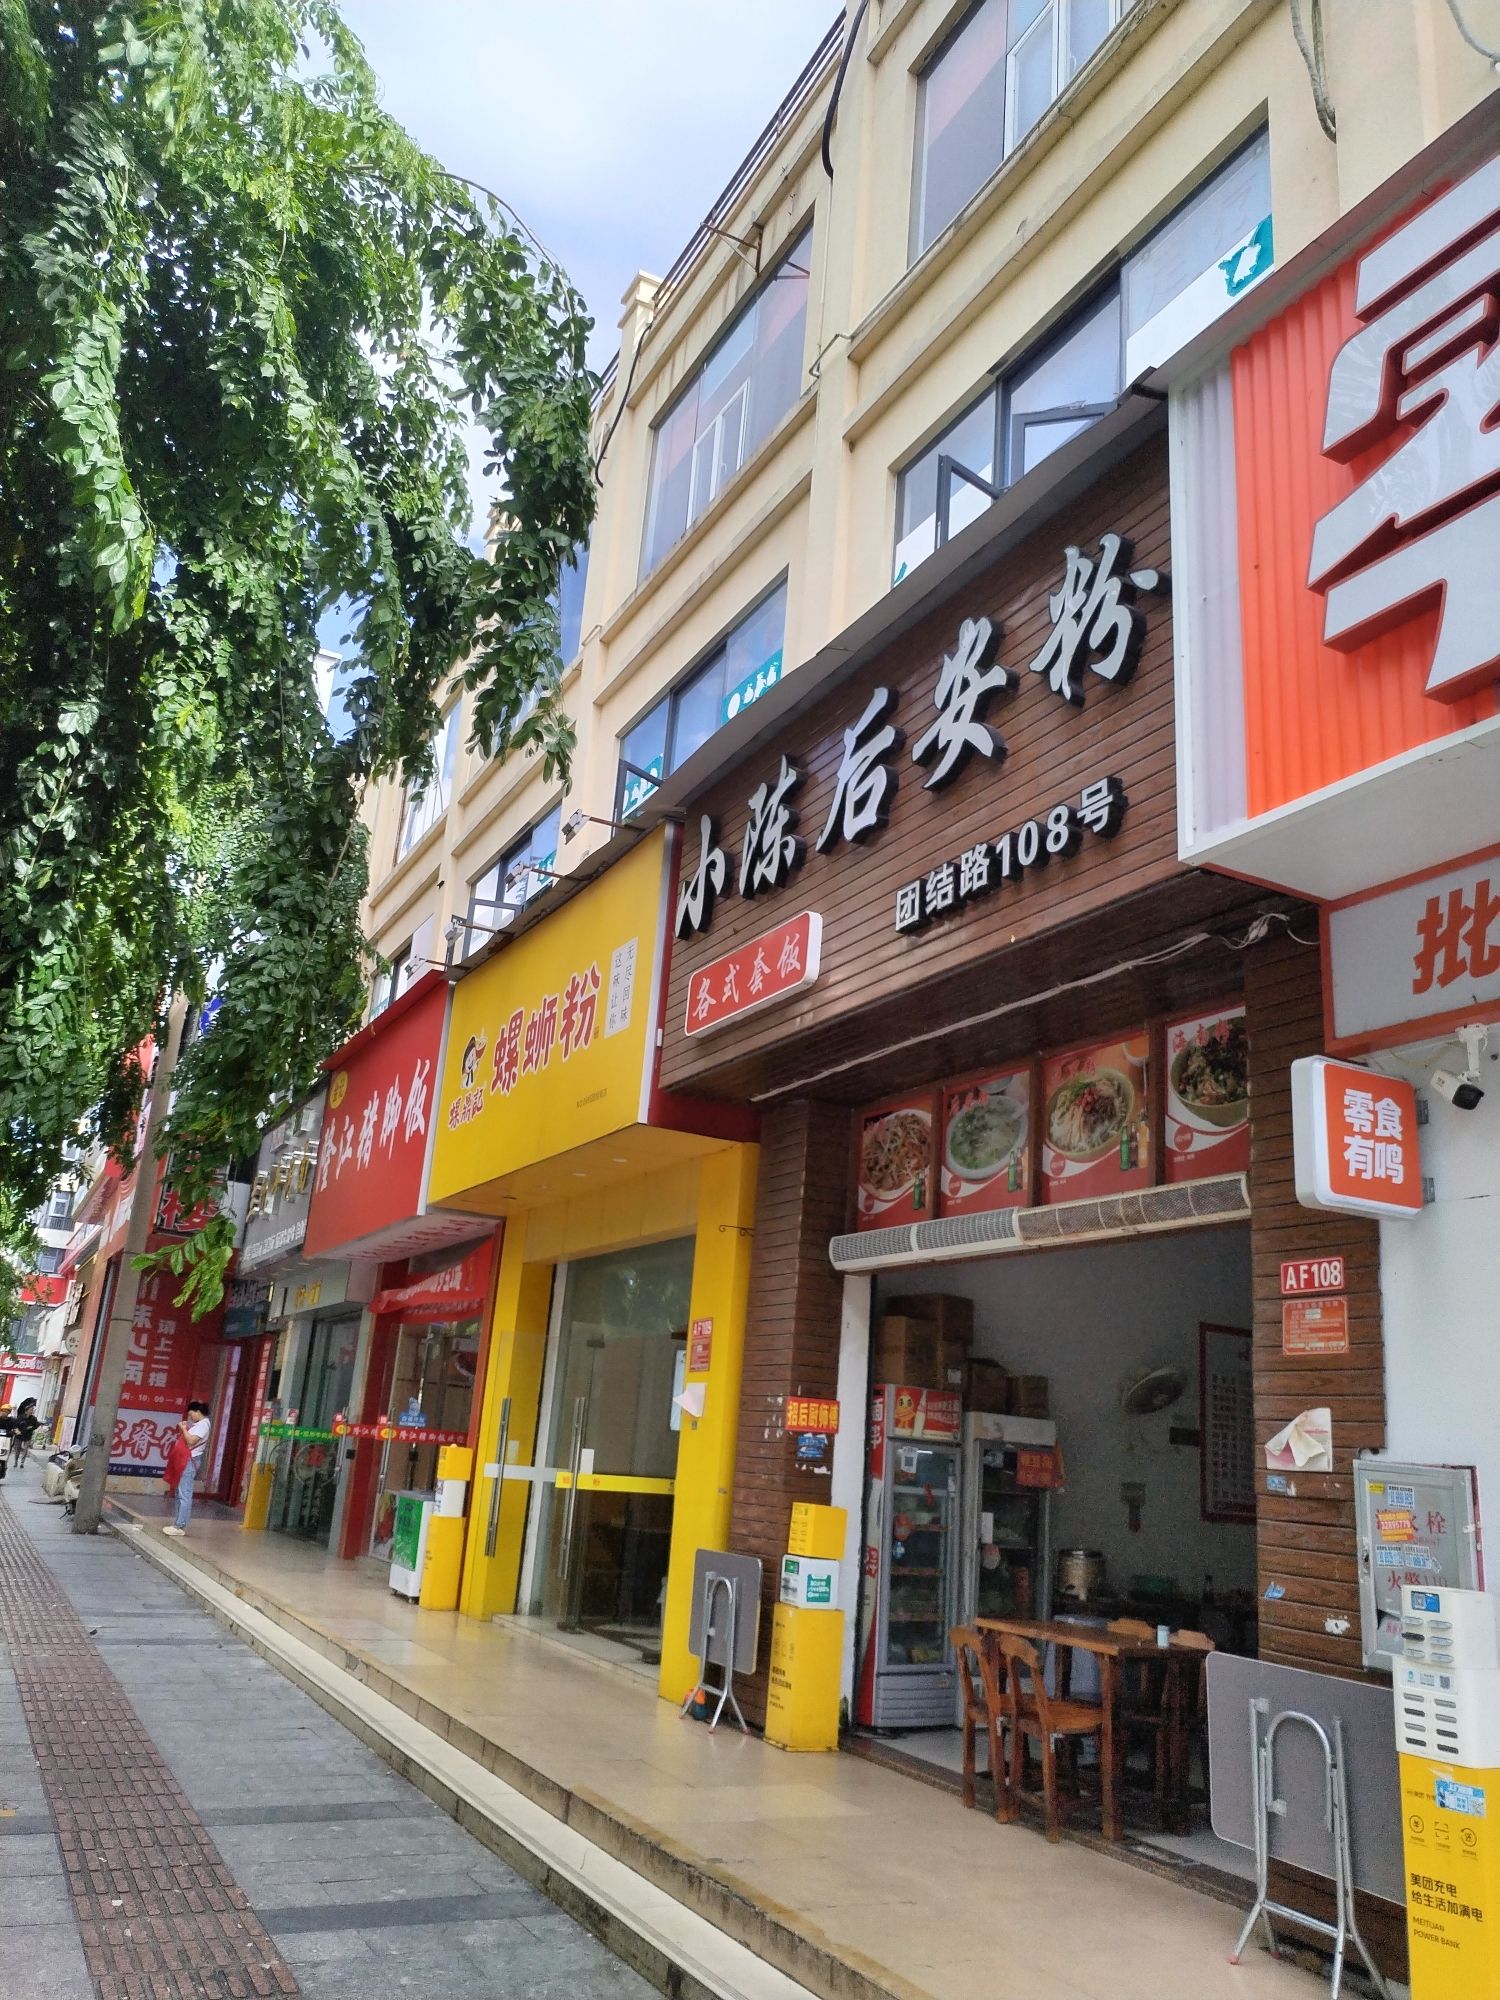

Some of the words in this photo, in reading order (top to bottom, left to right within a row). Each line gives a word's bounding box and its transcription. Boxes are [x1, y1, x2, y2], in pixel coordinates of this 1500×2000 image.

[674, 532, 1162, 939] 小陈后安粉
[895, 778, 1116, 933] 团结路108号
[692, 933, 801, 1021] 各式套饭
[489, 962, 602, 1094] 螺蛳粉
[314, 1058, 431, 1194] 隆江猪脚饭
[1343, 1088, 1404, 1141] 零食
[1343, 1134, 1404, 1184] 有鸣
[1285, 1261, 1341, 1290] AF108
[1410, 1872, 1457, 1898] 美团充电
[1411, 1889, 1484, 1923] 给生活加满电
[1412, 1916, 1445, 1932] MEITUAN
[1413, 1928, 1440, 1943] POWER
[1440, 1937, 1461, 1949] BANK
